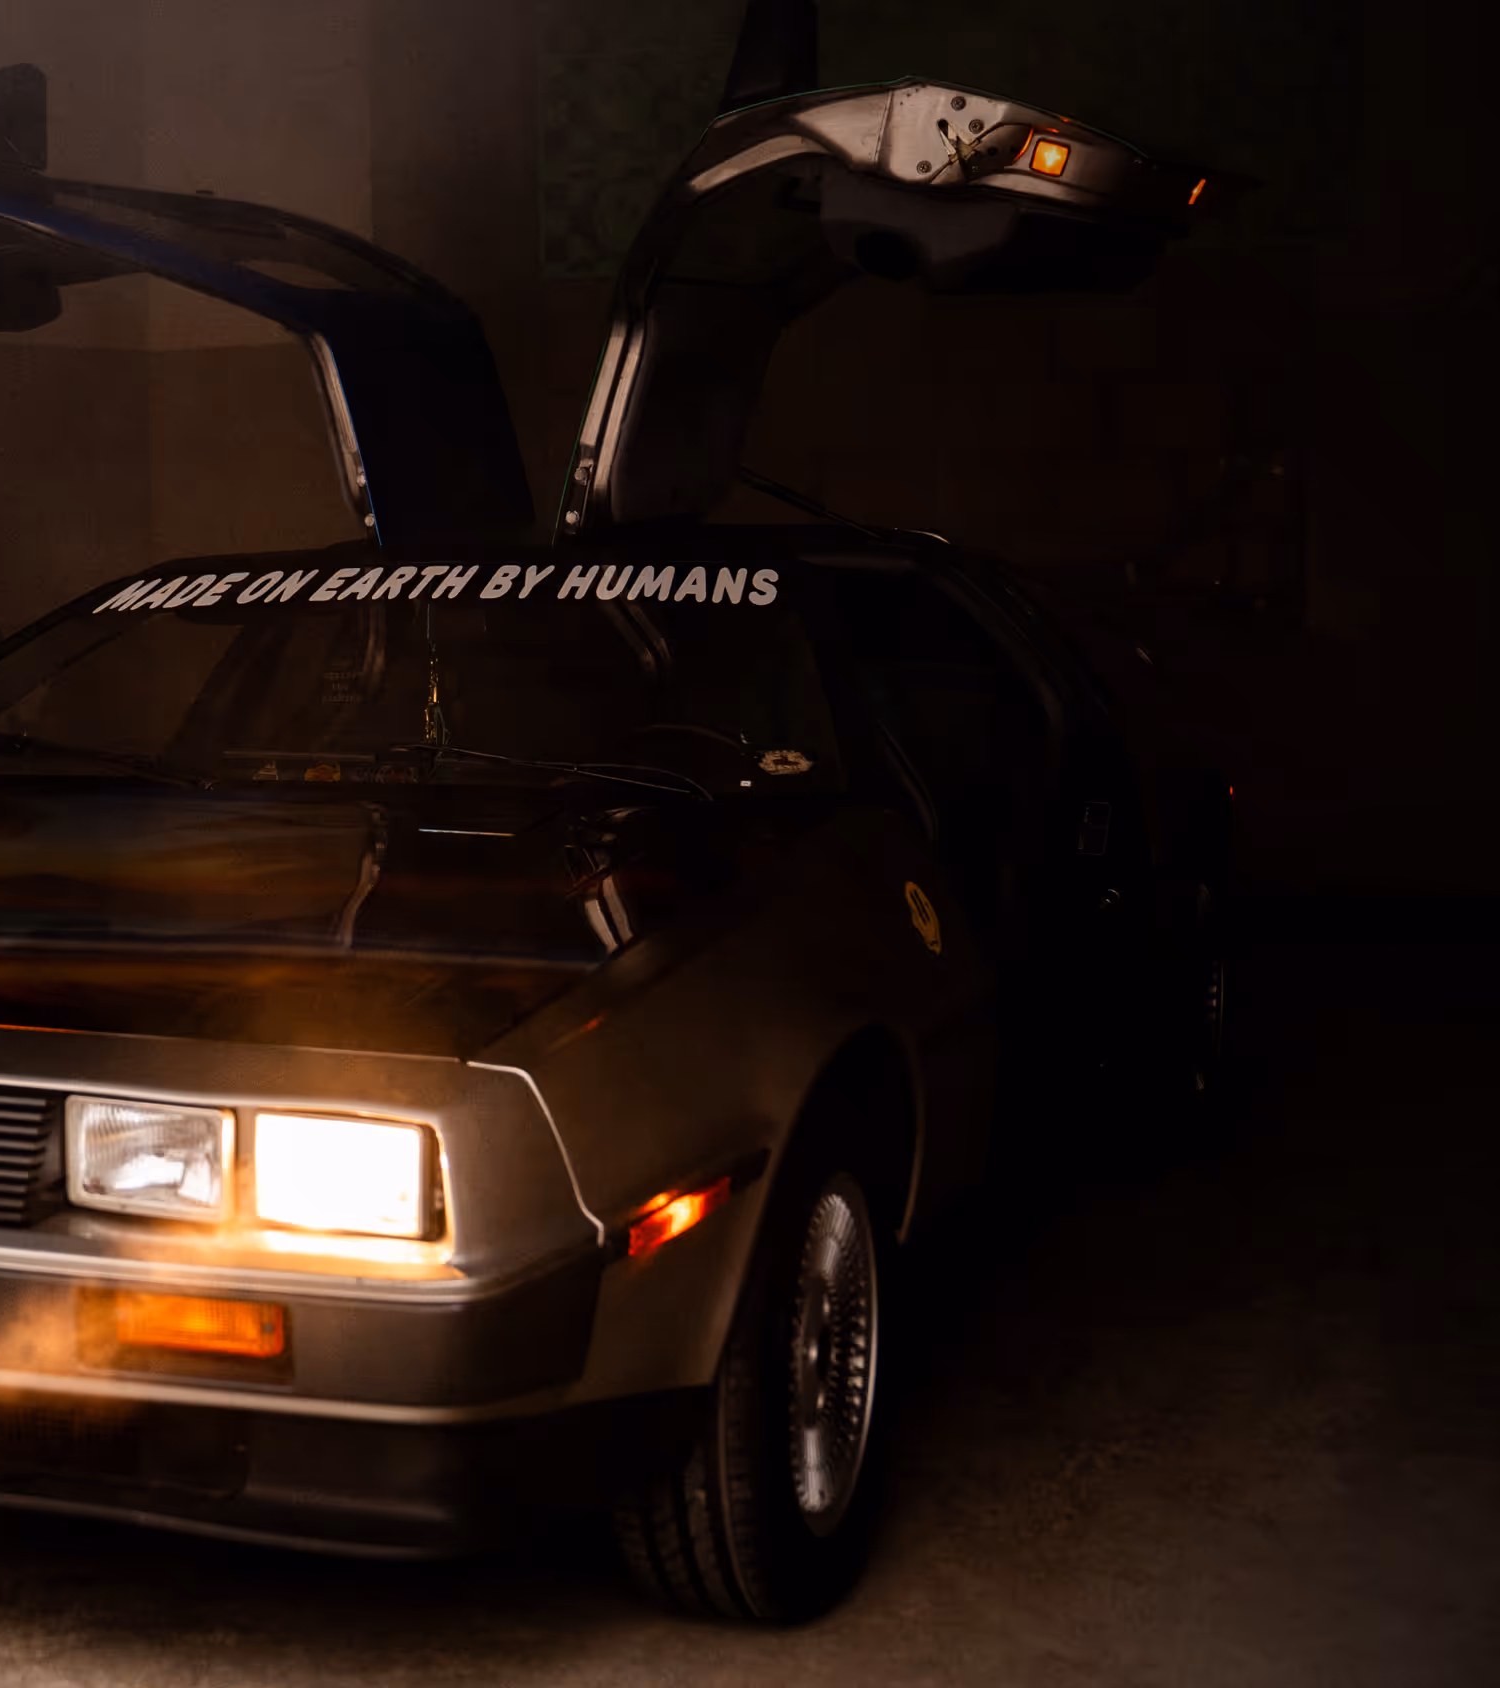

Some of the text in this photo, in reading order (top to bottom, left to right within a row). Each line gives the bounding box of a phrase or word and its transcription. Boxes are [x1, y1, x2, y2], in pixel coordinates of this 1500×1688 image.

[92, 565, 779, 614] MADE ON EARTH BY HUMANS
